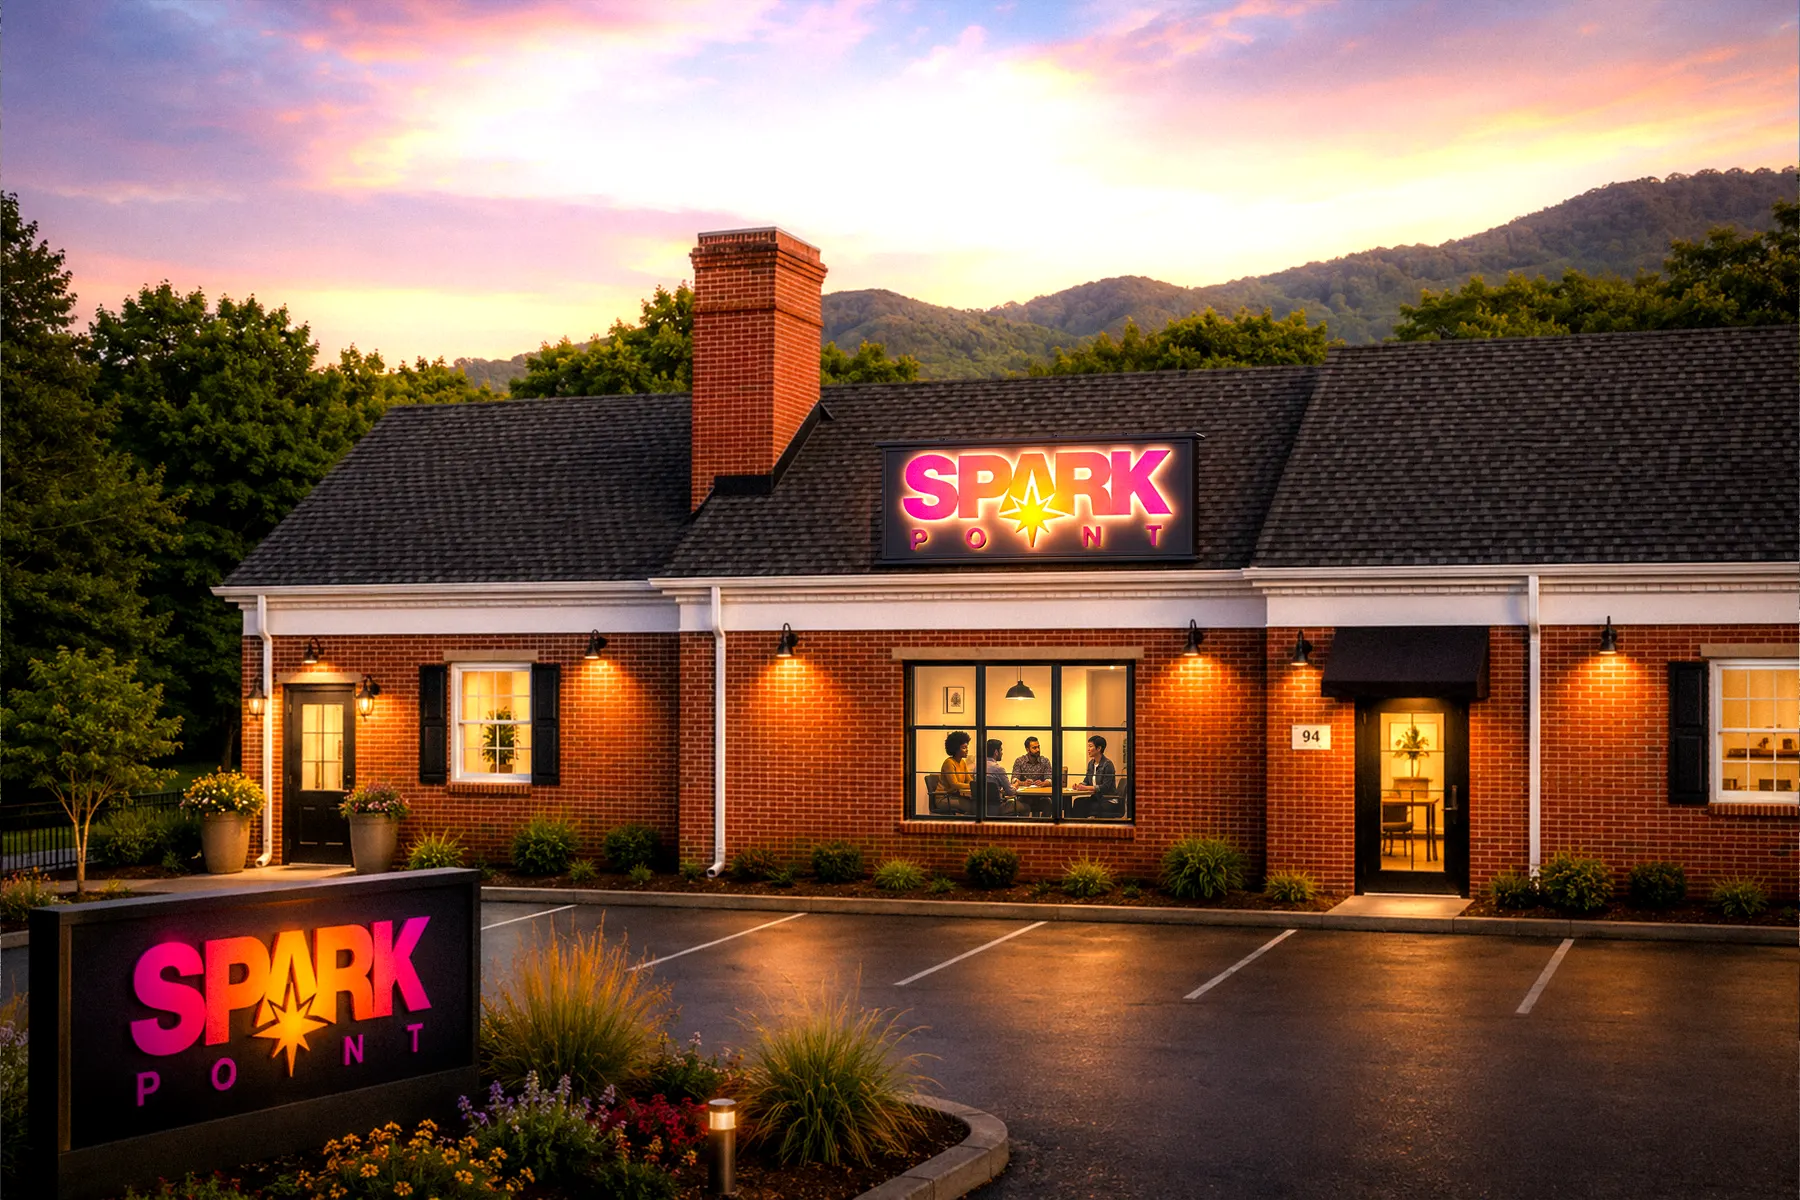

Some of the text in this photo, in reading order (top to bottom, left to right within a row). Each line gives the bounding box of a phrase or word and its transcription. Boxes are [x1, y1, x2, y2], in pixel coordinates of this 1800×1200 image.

[903, 449, 1172, 520] SPARK
[1302, 729, 1320, 743] 94
[130, 916, 432, 1056] SPARK
